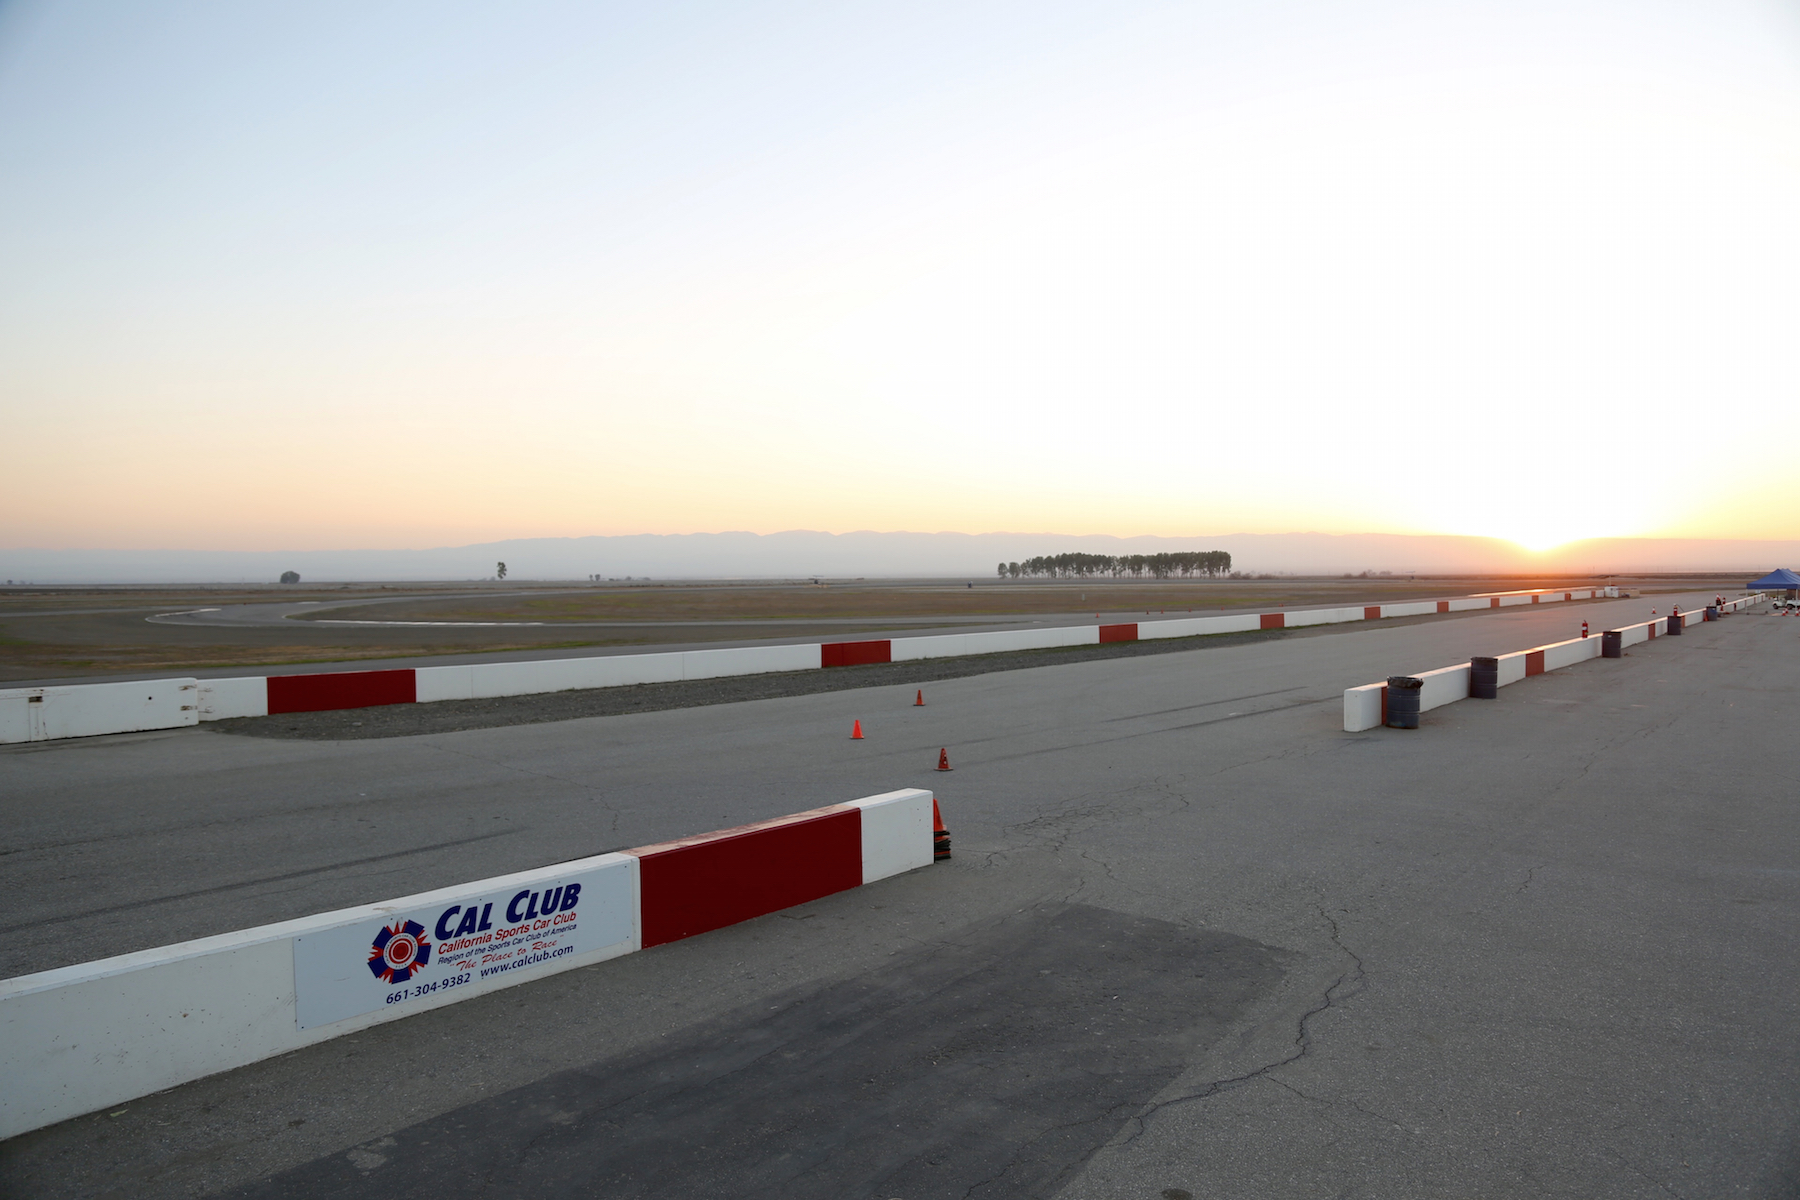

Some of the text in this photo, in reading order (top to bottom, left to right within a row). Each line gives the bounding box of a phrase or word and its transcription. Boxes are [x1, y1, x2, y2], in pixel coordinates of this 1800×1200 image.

[435, 883, 581, 941] CAL CLUB
[438, 911, 577, 955] California Sports Car Club
[437, 924, 577, 965] Region of the Sports Car Club of America
[481, 953, 513, 966] Place
[517, 947, 527, 956] to
[386, 945, 574, 1004] 661-304-9382 www.calclub.com
